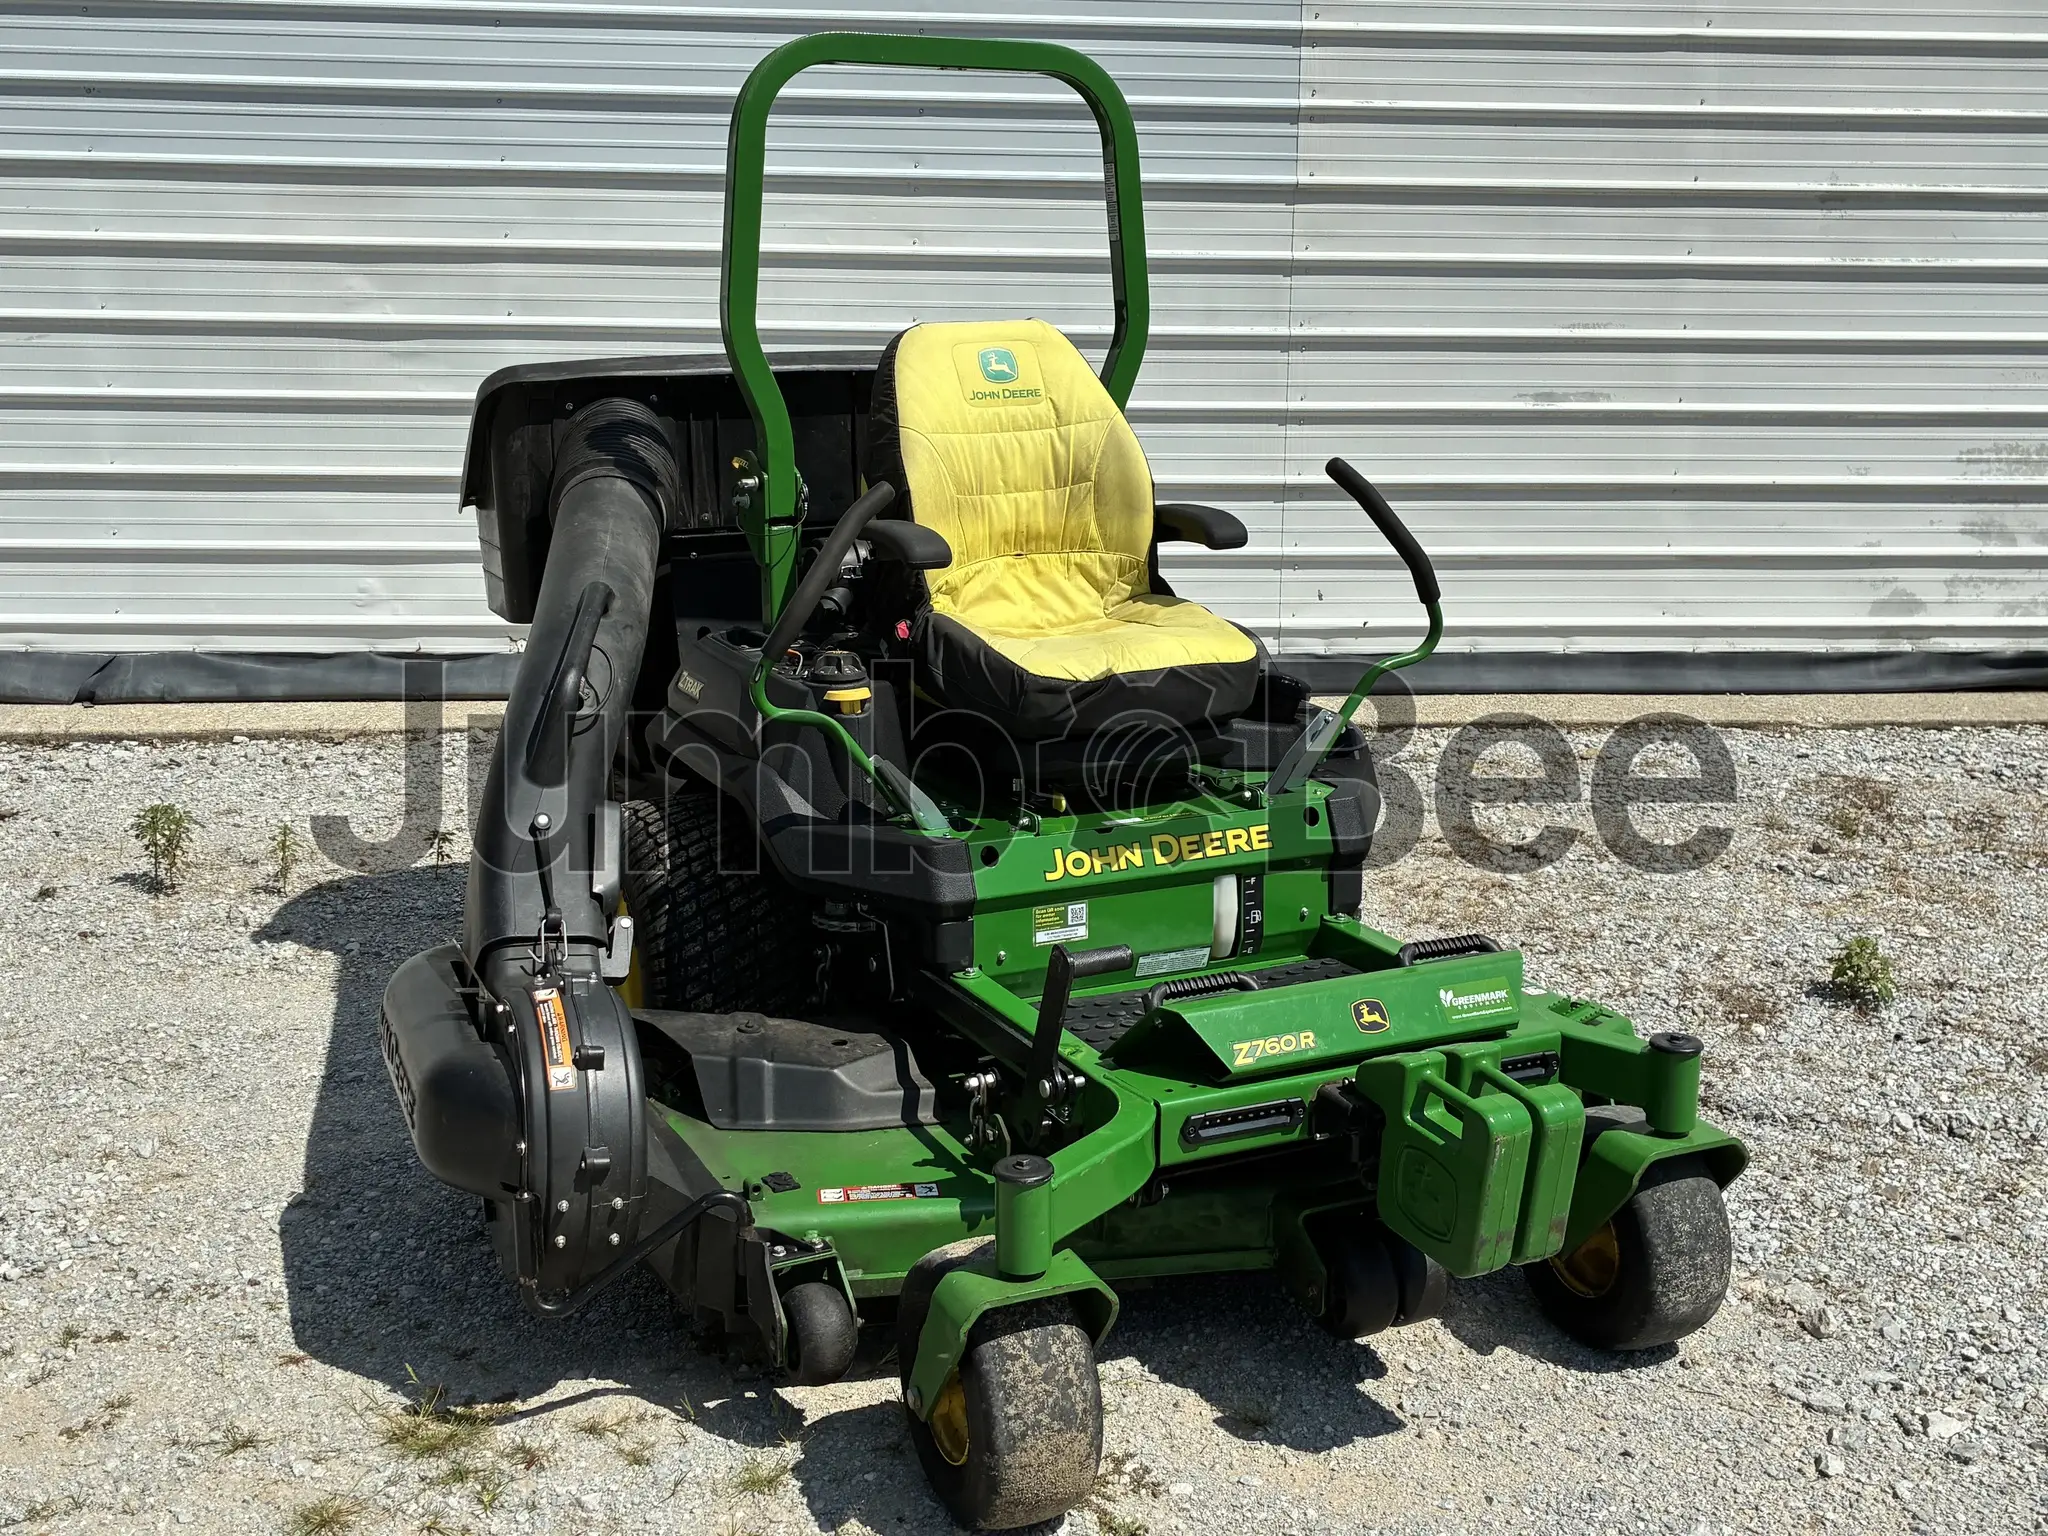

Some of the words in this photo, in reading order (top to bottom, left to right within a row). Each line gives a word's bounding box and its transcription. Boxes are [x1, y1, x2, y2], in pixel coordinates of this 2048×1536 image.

[969, 389, 1001, 401] JOHN
[1002, 388, 1042, 399] DEERE
[1044, 841, 1144, 882] JOHN
[1150, 824, 1273, 866] DEERE
[1451, 990, 1509, 1007] GREENMARK
